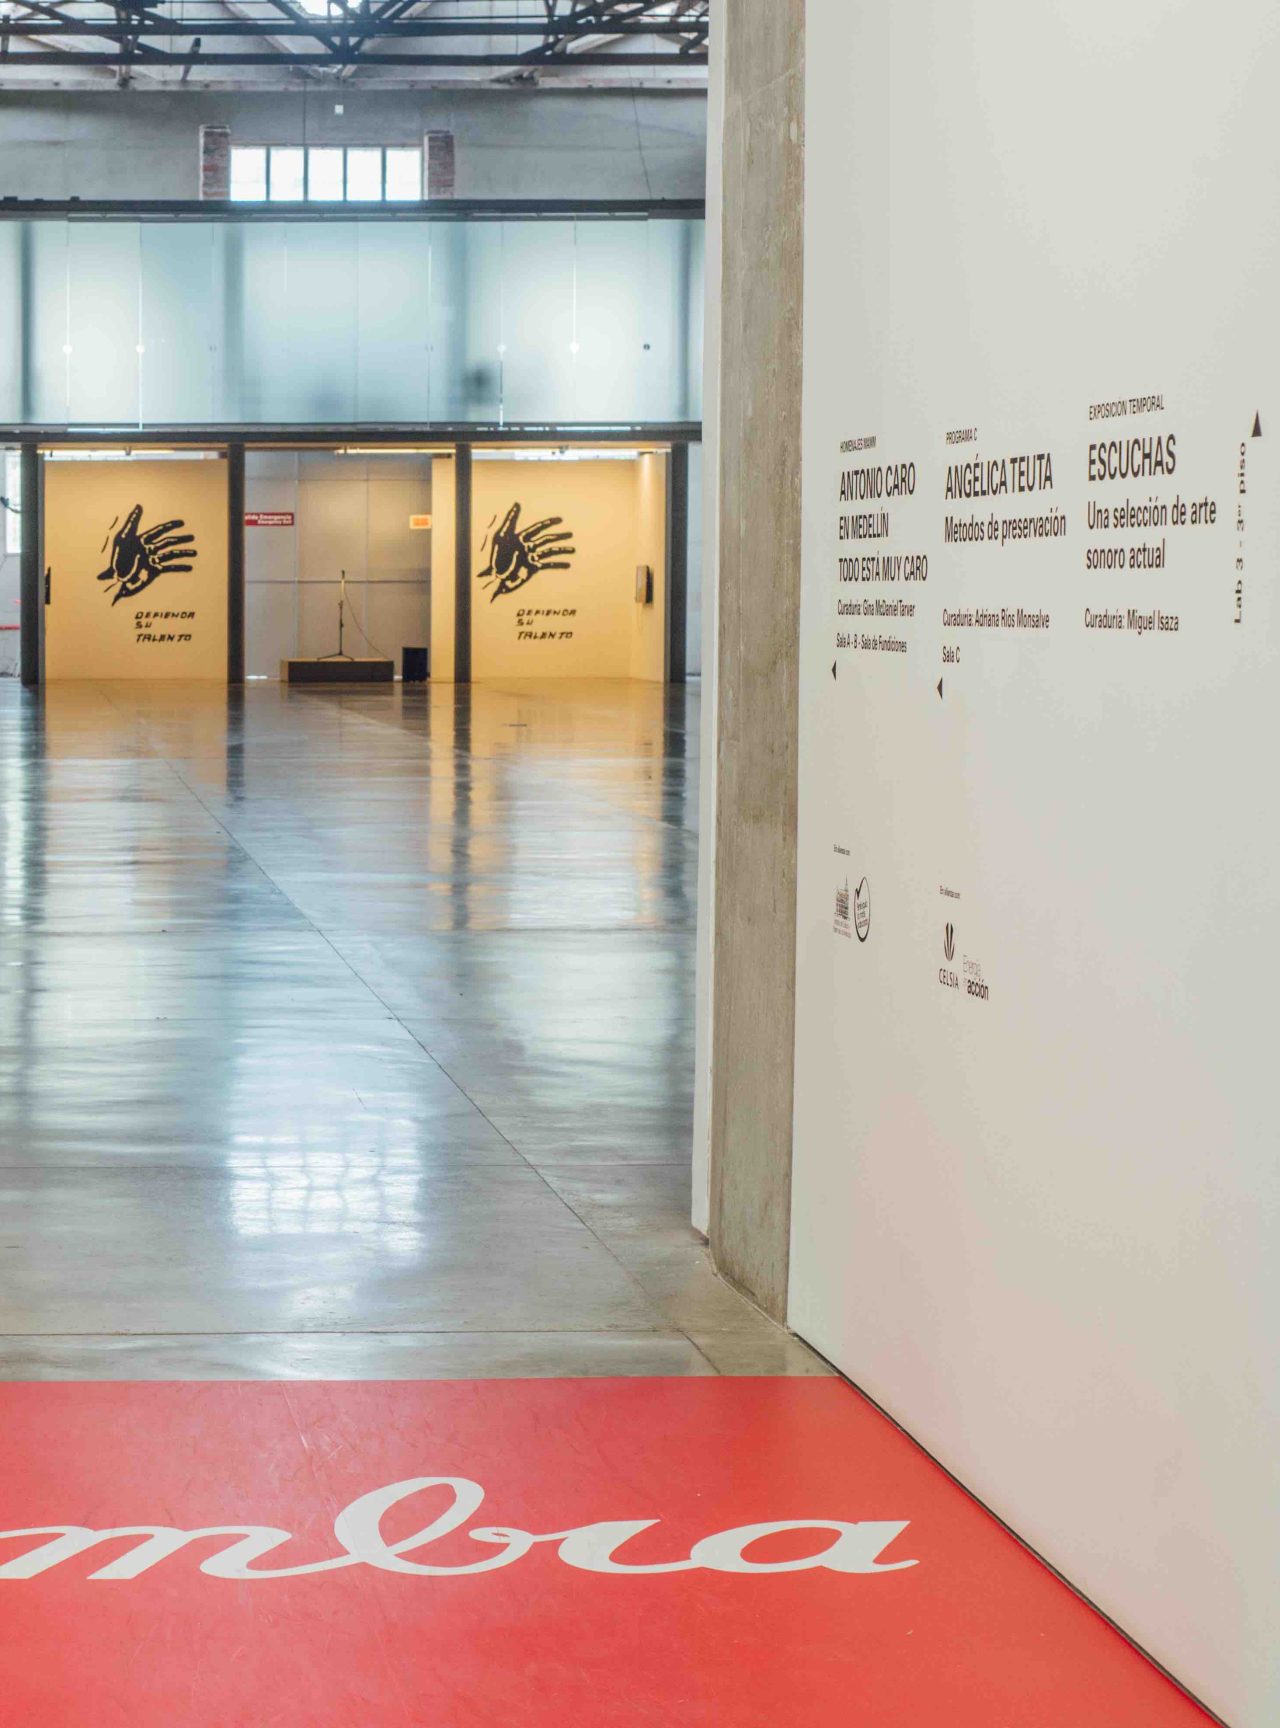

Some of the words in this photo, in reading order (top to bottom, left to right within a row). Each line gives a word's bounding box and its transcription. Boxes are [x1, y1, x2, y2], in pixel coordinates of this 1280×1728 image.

[1129, 394, 1164, 414] TEMPORAL
[946, 428, 973, 445] PROGRAMA
[973, 427, 978, 441] C
[1088, 433, 1176, 482] ESCUCHAS
[1238, 442, 1246, 494] piso
[839, 465, 883, 502] ANTONIO
[885, 461, 915, 498] CARO
[945, 453, 1008, 500] ANGÉLICA
[1009, 452, 1053, 493] TEUTA
[1088, 500, 1109, 530] Una
[1113, 495, 1167, 529] selección
[1171, 494, 1186, 526] de
[1191, 496, 1217, 525] arte
[839, 516, 850, 540] EN
[851, 506, 889, 540] MEDELLÍN
[987, 512, 999, 541] de
[1001, 506, 1066, 547] preservación
[1086, 547, 1125, 570] sonoro
[1129, 537, 1166, 569] actual
[1236, 557, 1244, 570] 3
[839, 557, 860, 582] TODO
[861, 550, 880, 581] ESTÁ
[881, 556, 902, 581] MUY
[903, 554, 928, 581] CARO
[515, 608, 577, 617] DEFIENDA
[862, 599, 875, 616] Gina
[875, 599, 899, 616] McDaniel
[898, 600, 916, 617] Tarver
[1234, 580, 1243, 624] Lab
[134, 611, 196, 620] DEFIENDA
[134, 620, 153, 629] SU
[515, 618, 534, 627] SU
[974, 608, 1000, 628] Adriana
[1000, 608, 1016, 628] Ríos
[1016, 608, 1050, 629] Monsalve
[1084, 607, 1125, 630] Curaduría:
[1126, 609, 1156, 635] Miguel
[1157, 610, 1180, 631] Isaza
[136, 633, 192, 643] TALENTO
[517, 630, 573, 640] TALENTO
[836, 632, 847, 648] Sala
[846, 633, 851, 648] A
[854, 633, 858, 649] B
[861, 634, 872, 650] Sala
[871, 635, 878, 650] de
[878, 635, 908, 653] Fundiciones
[942, 645, 955, 662] Sala
[955, 646, 961, 663] C
[938, 968, 960, 990] CELSIA
[967, 978, 989, 1000] acción
